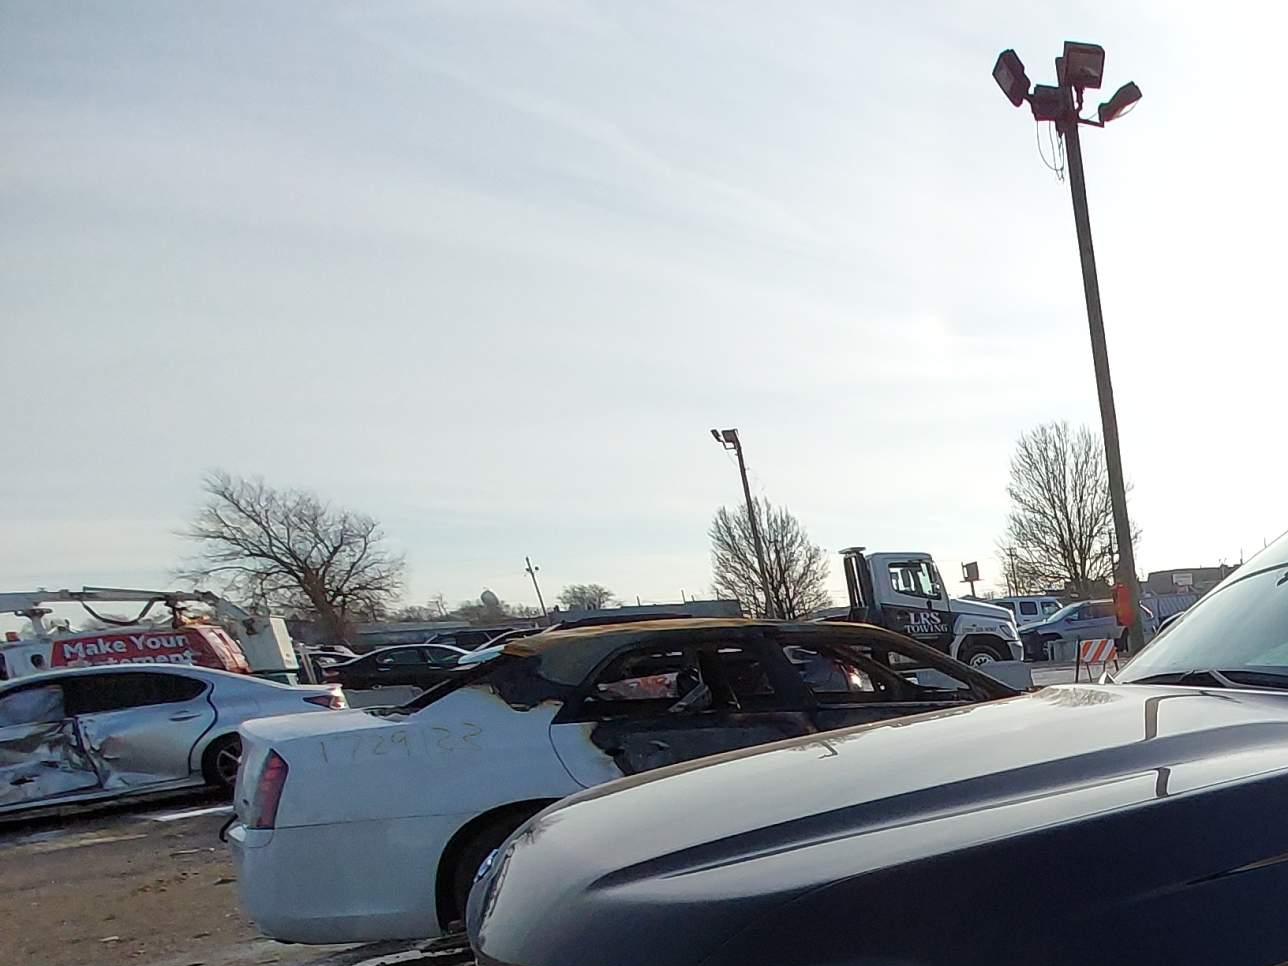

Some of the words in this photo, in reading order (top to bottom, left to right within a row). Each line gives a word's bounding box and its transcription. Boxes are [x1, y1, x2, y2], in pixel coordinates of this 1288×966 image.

[910, 612, 941, 624] LRS
[904, 624, 947, 633] TOWING
[64, 638, 126, 658] Make
[130, 635, 188, 649] Your
